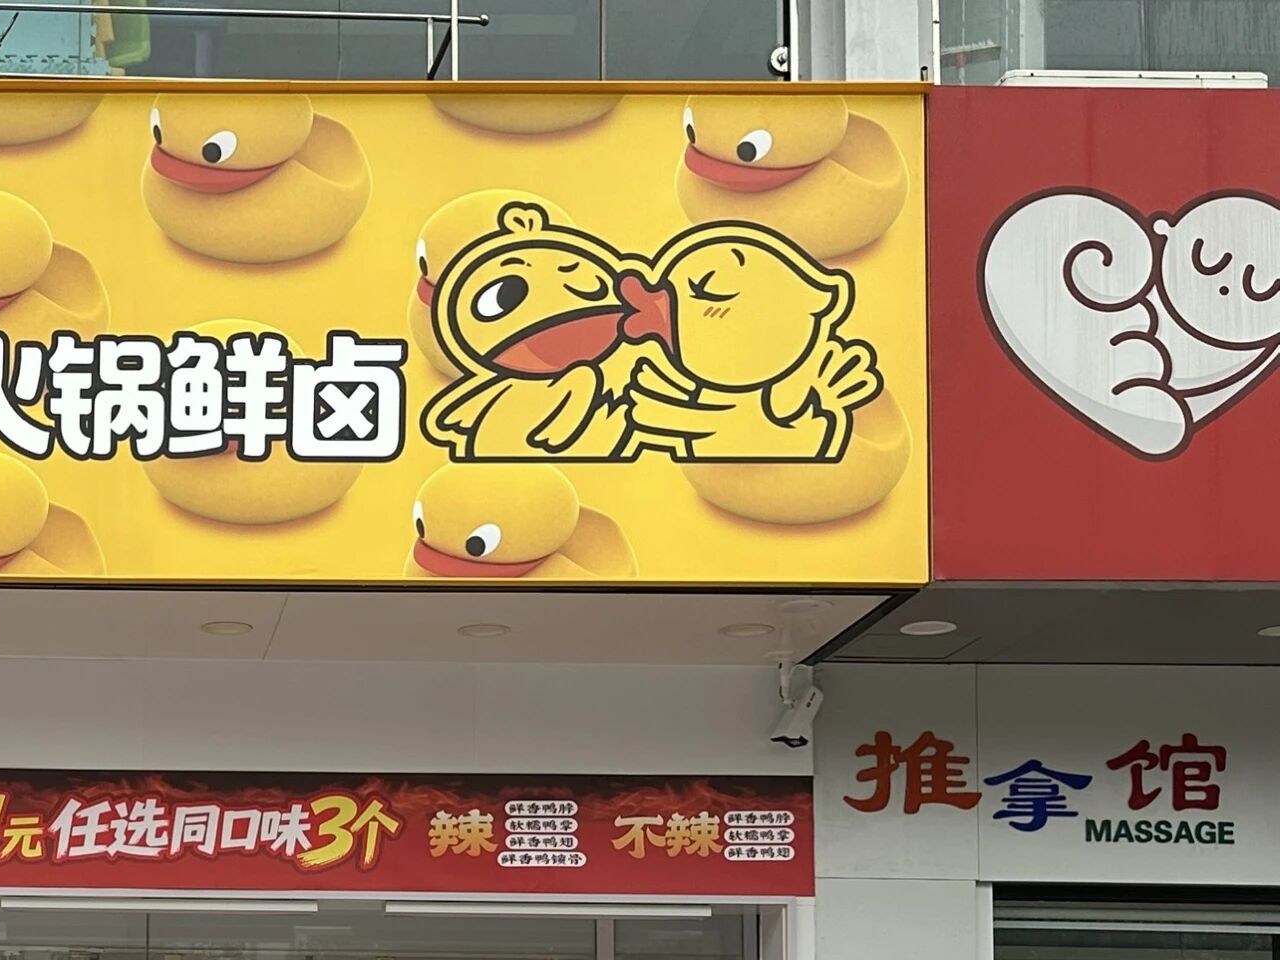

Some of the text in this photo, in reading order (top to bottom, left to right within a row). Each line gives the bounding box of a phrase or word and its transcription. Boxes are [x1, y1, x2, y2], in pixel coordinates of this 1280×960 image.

[843, 730, 1227, 832] 推拿馆
[509, 802, 575, 814] 鲜香鸭脖
[428, 809, 498, 857] 辣
[509, 836, 574, 848] 鲜香鸭翅
[611, 810, 722, 859] 不辣
[1086, 819, 1235, 845] MASSAGE
